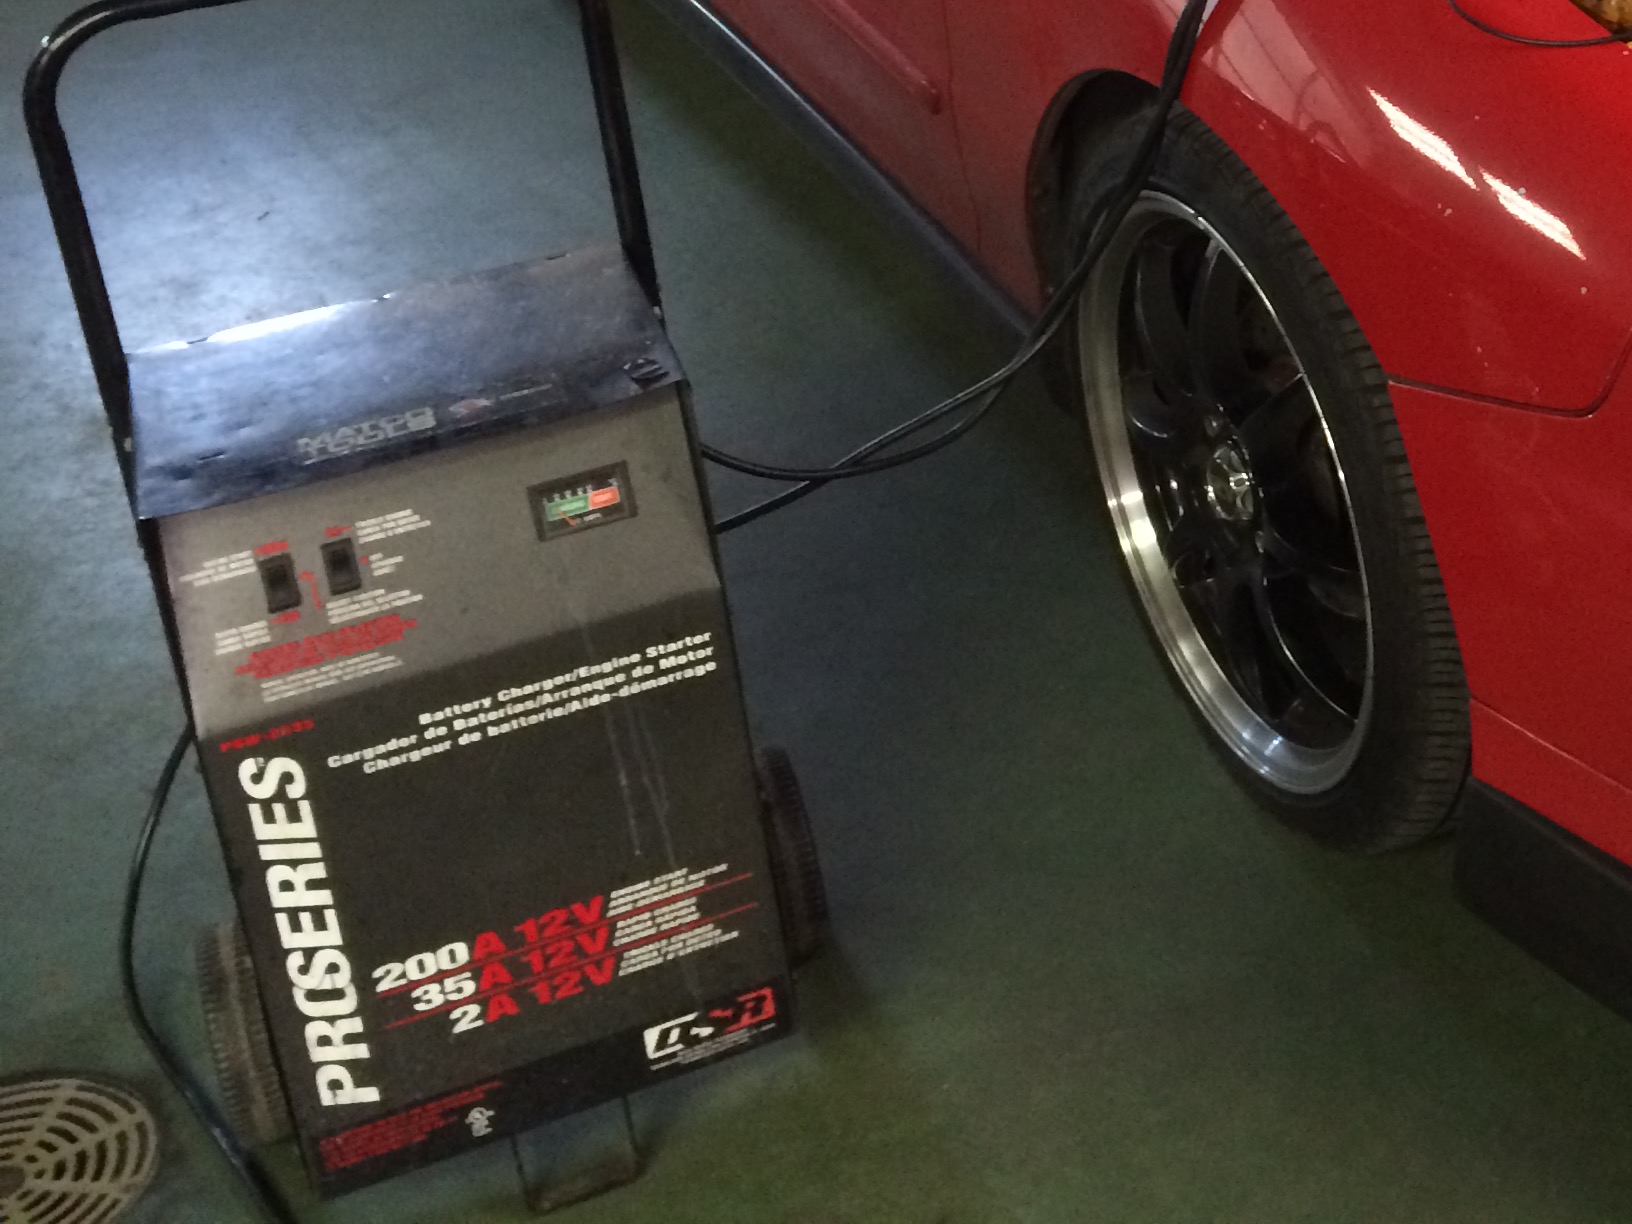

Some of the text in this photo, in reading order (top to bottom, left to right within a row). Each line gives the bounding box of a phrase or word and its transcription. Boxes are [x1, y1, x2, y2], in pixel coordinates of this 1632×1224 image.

[327, 734, 418, 768] Cargador
[424, 726, 449, 740] de
[631, 664, 655, 678] de
[659, 645, 714, 670] Motor
[419, 632, 712, 725] Battery Charger/Engine Starter
[363, 740, 453, 774] Chargeur
[458, 731, 482, 745] de
[238, 756, 380, 1106] PROSERIES
[372, 930, 506, 992] 200A
[514, 895, 604, 944] 12V
[411, 962, 513, 1011] 35A
[521, 926, 610, 974] 12V
[449, 955, 617, 1034] 2A 12V
